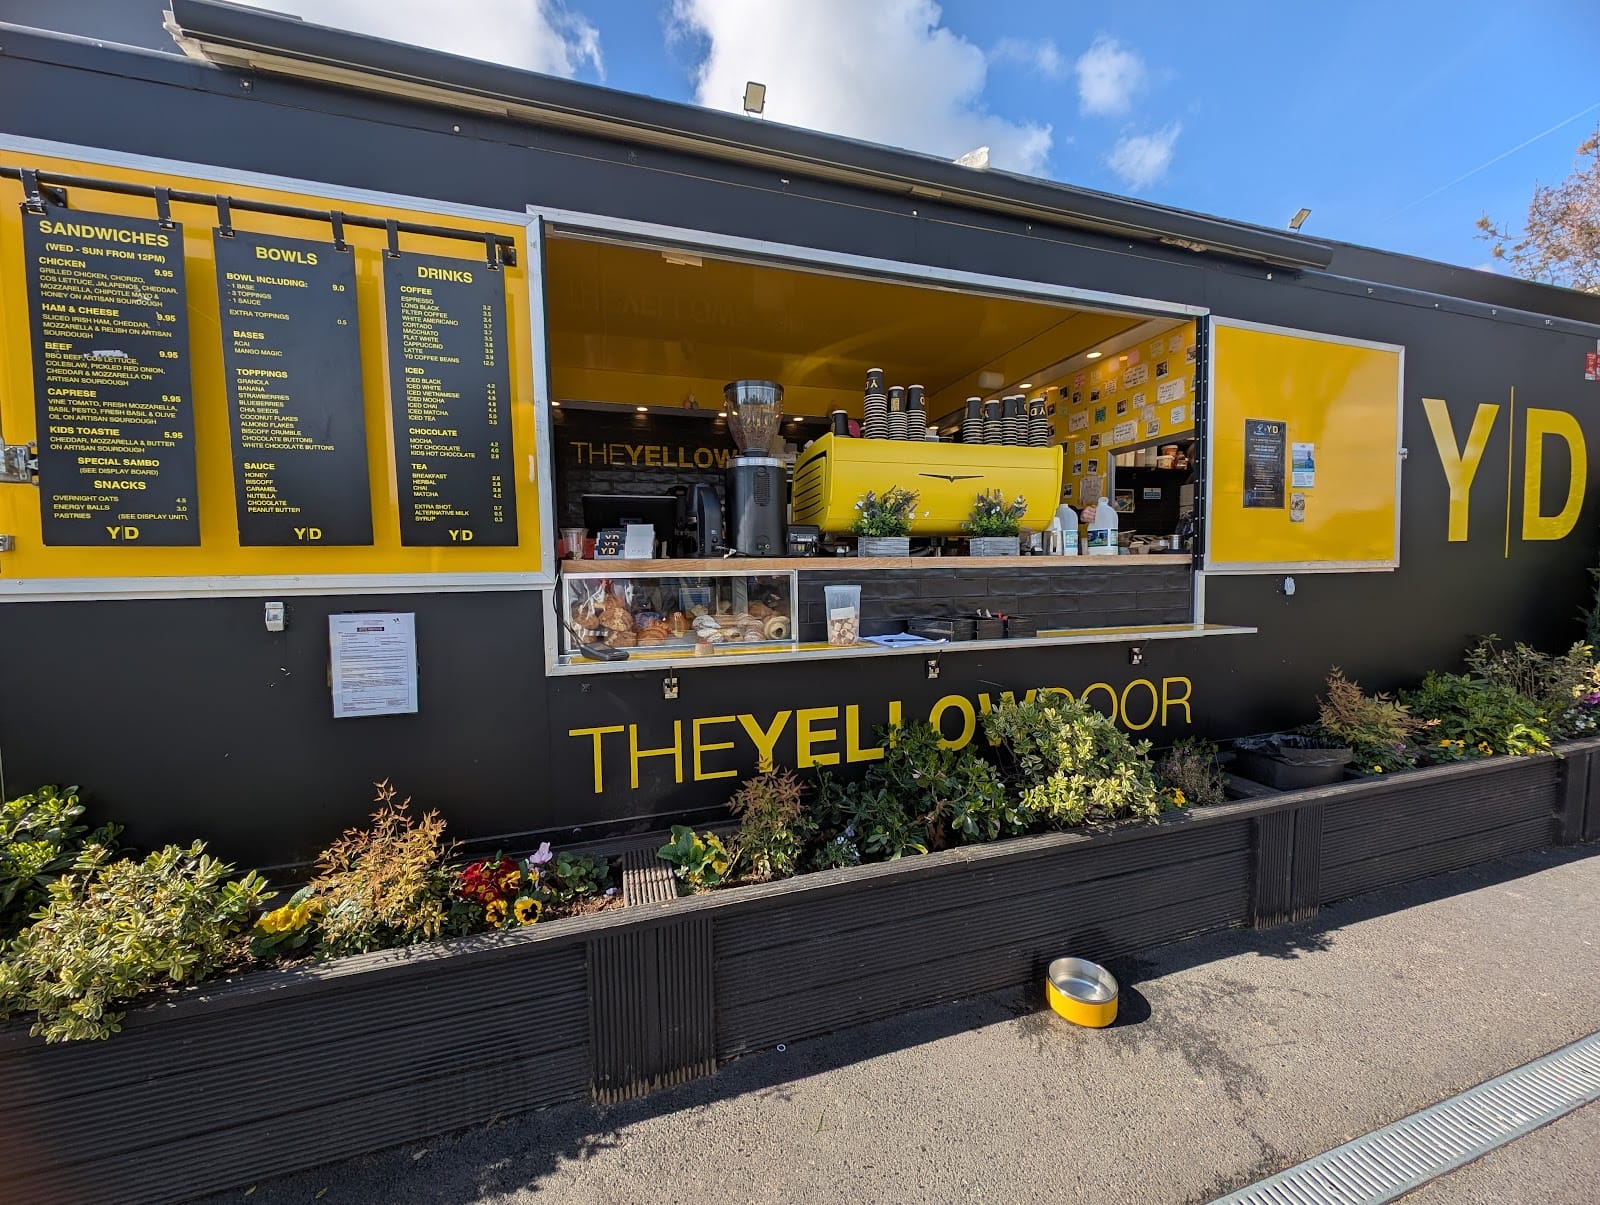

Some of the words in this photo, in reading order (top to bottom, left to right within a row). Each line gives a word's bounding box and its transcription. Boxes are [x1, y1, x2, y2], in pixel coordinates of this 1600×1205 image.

[39, 220, 168, 247] SANDWICHES
[45, 242, 73, 252] (WED
[81, 246, 103, 256] SUN
[105, 249, 134, 259] FROM
[137, 253, 165, 264] 12PM)
[255, 246, 317, 265] BOWLS
[38, 256, 85, 268] CHICKEN
[154, 268, 173, 277] 9.95
[39, 266, 72, 275] GRILLED
[73, 270, 109, 280] CHICKEN,
[110, 274, 145, 283] CHORIZO,
[226, 272, 255, 282] BOWL
[256, 275, 307, 287] INCLUDING:
[417, 266, 472, 283] DRINKS
[40, 282, 92, 293] MOZZARELLA,
[93, 287, 130, 296] CHIPOTLE
[141, 285, 178, 294] CHEDDAR,
[400, 285, 432, 295] COFFEE
[82, 294, 114, 302] ARTISAN
[115, 297, 162, 307] SOURDOUGH
[42, 303, 65, 312] HAM
[78, 306, 119, 316] CHEESE
[155, 313, 176, 321] 9.95
[253, 311, 289, 320] TOPPINGS
[42, 321, 93, 330] MOZZARELLA
[112, 319, 150, 328] CHEDDAR,
[43, 329, 93, 338] SOURDOUGH
[233, 330, 264, 339] BASES
[44, 341, 72, 350] BEEF
[45, 359, 89, 369] COLESLAW,
[91, 370, 139, 379] MOZZARELLA
[80, 377, 128, 385] SOURDOUGH
[47, 387, 96, 397] CAPRESE
[128, 402, 177, 411] MOZZARELLA,
[49, 426, 74, 434] KIDS
[75, 427, 120, 436] TOASTIE
[409, 427, 457, 436] CHOCOLATE
[77, 456, 121, 465] SPECIAL
[94, 480, 146, 489] SNACKS
